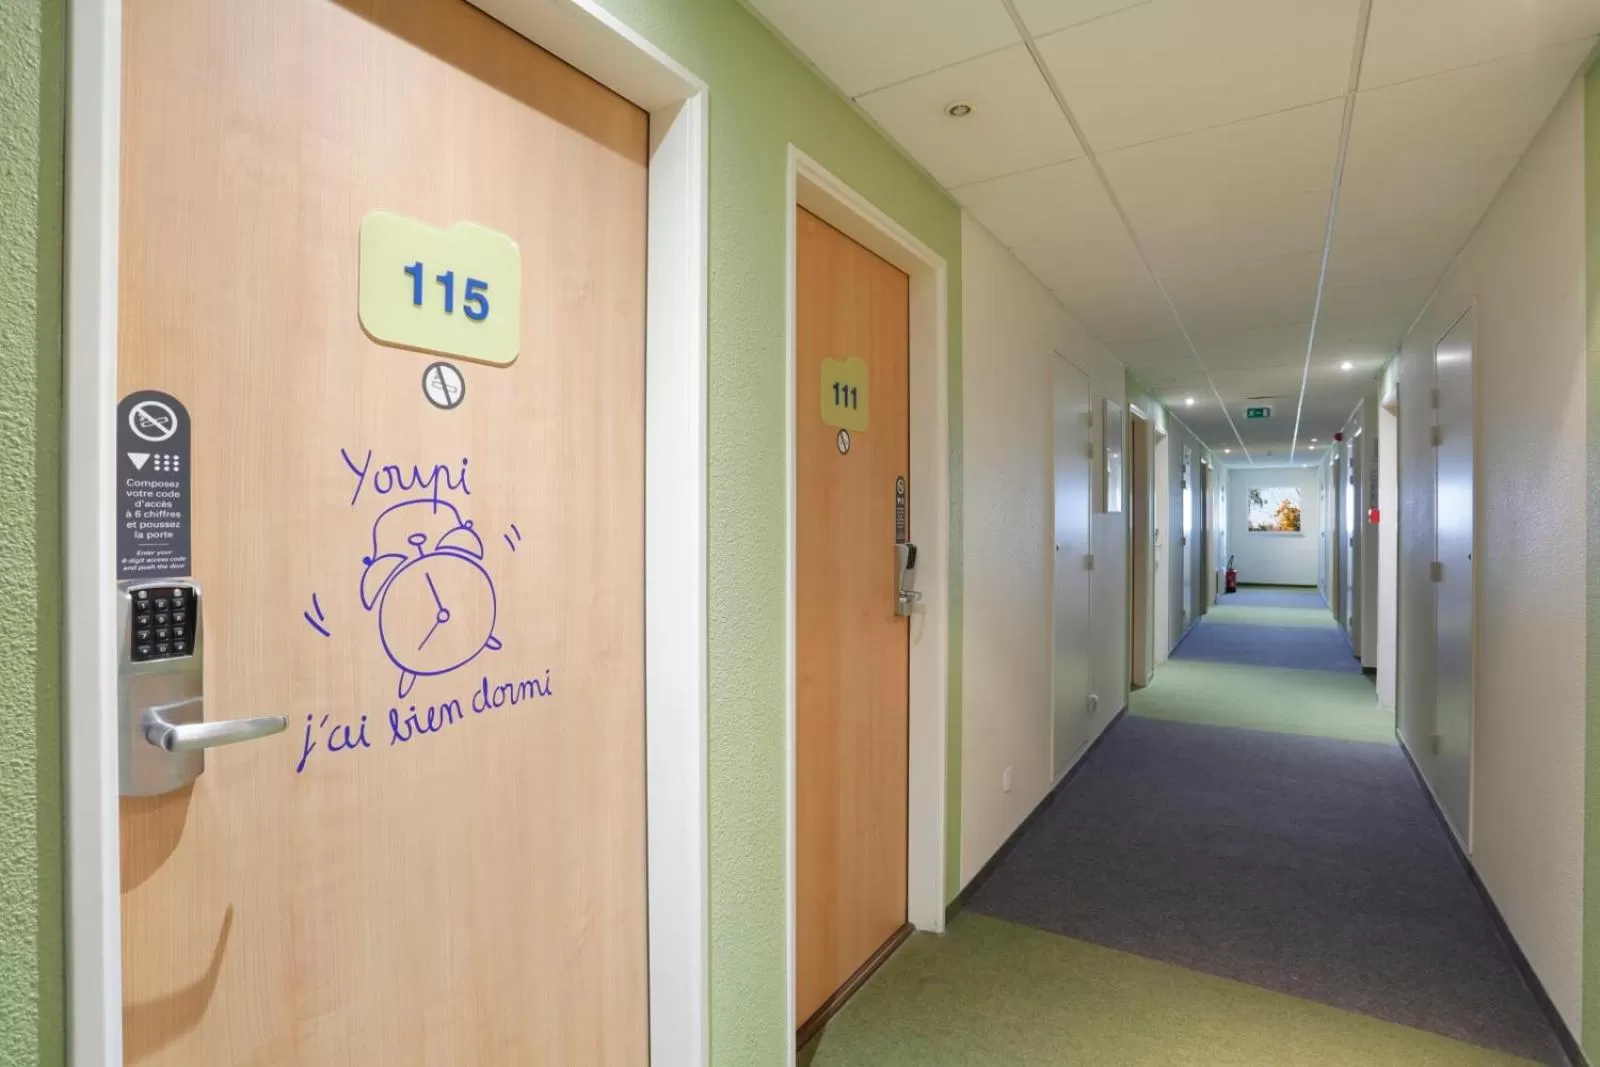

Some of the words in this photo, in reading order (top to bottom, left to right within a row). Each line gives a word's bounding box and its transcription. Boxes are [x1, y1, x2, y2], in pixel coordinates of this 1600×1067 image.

[404, 260, 489, 321] 115
[832, 382, 858, 410] 111
[126, 478, 180, 488] Composez
[340, 447, 471, 515] Youpi
[135, 500, 173, 508] d'accès
[126, 510, 132, 518] à
[144, 510, 181, 518] chiffres
[139, 521, 181, 530] poussez
[147, 532, 173, 540] porte
[296, 712, 371, 773] j'ai
[388, 696, 464, 746] bien
[472, 668, 553, 714] dormi
